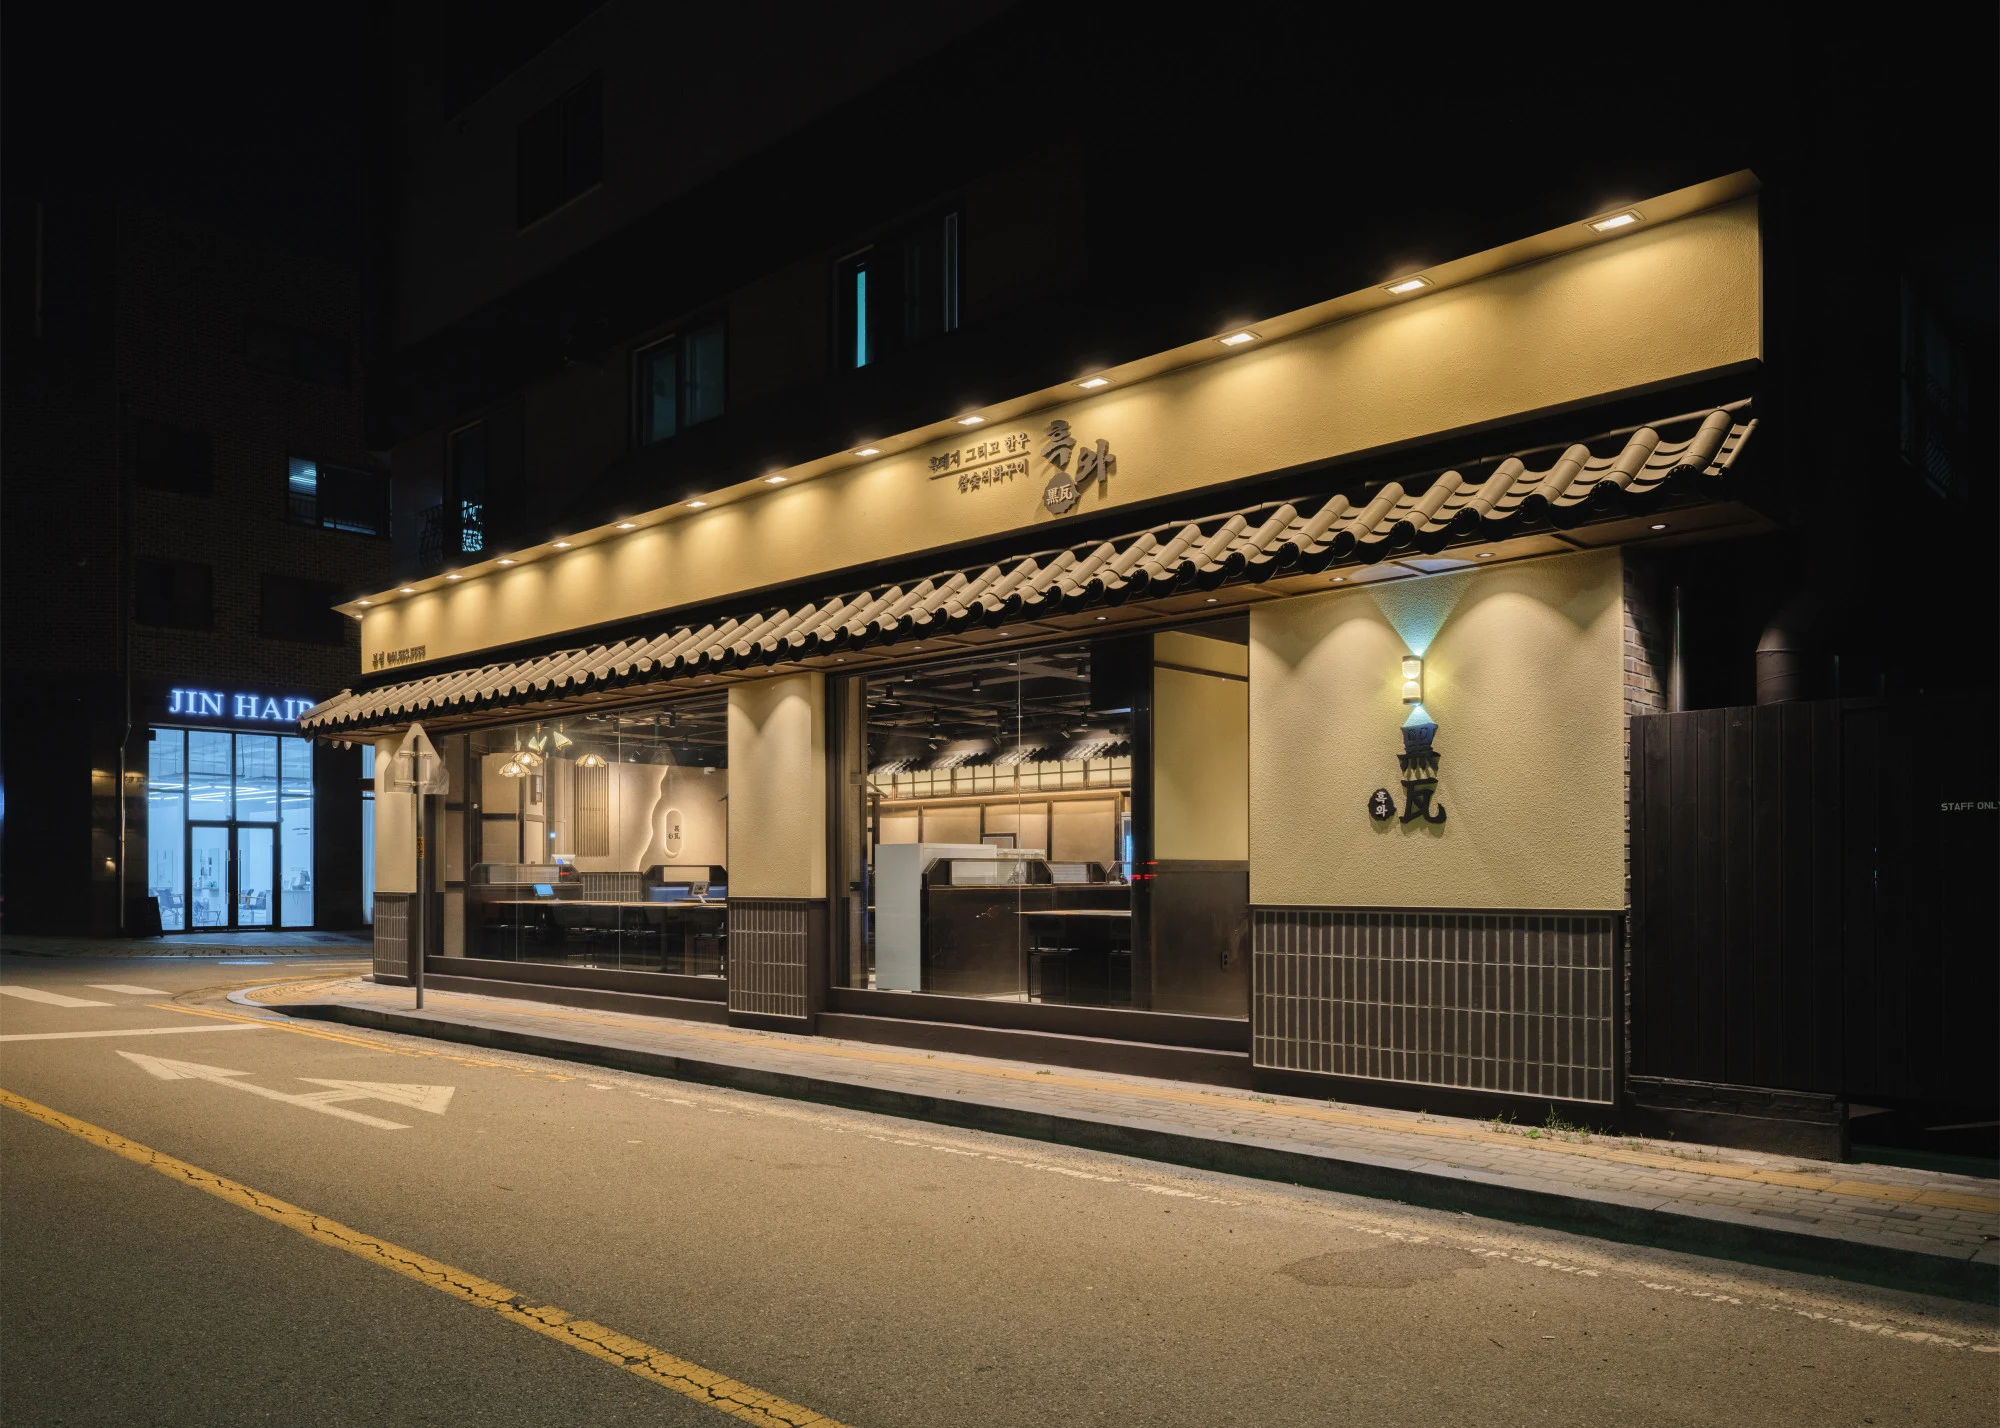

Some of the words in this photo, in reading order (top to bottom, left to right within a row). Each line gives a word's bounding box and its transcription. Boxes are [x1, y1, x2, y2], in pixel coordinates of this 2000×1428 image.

[965, 441, 1000, 462] 그리고
[1004, 432, 1030, 452] 한우
[1040, 420, 1116, 483] 흑와
[169, 689, 225, 715] JIN
[1941, 802, 1974, 811] STAFF
